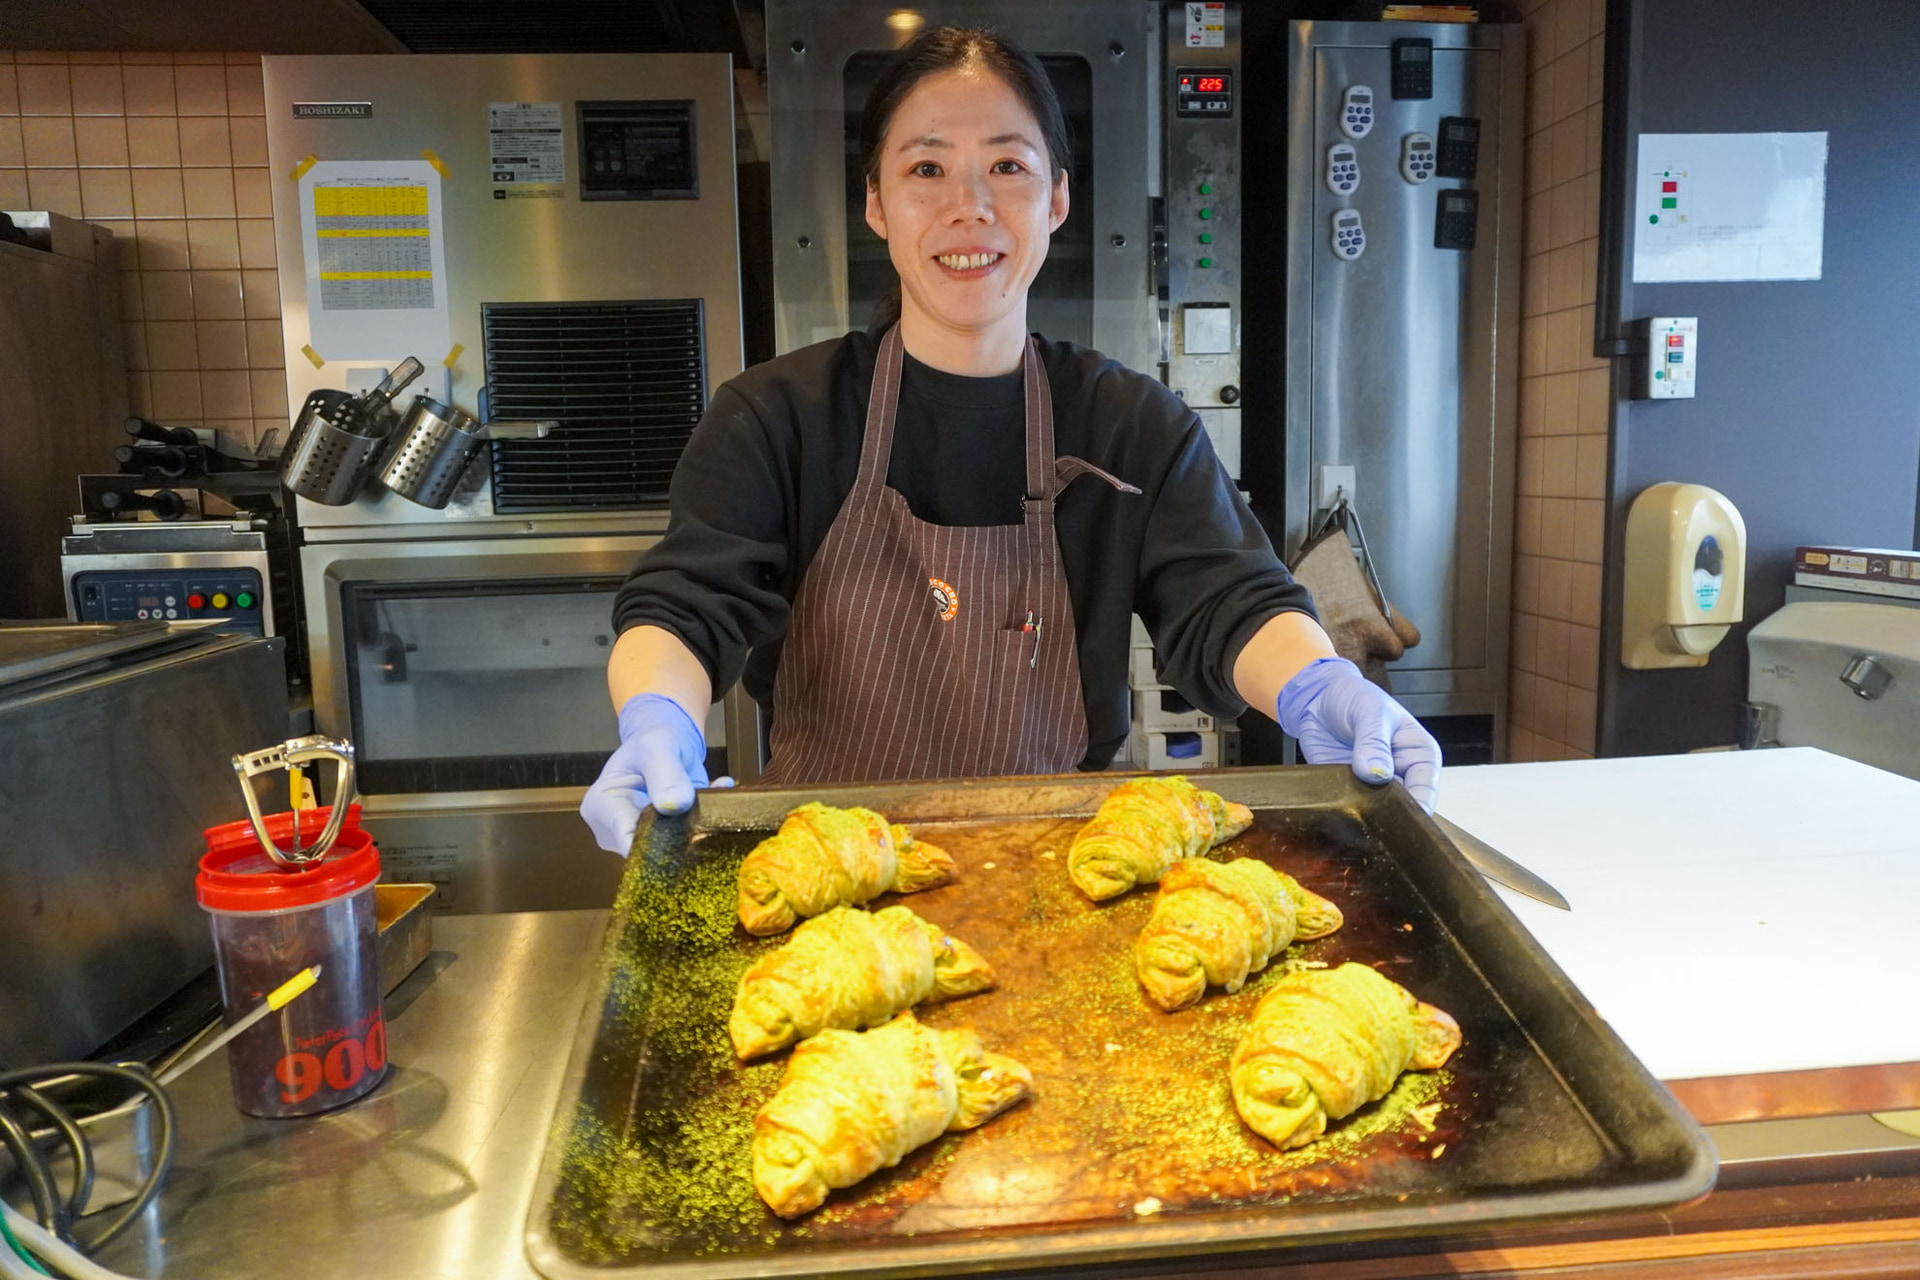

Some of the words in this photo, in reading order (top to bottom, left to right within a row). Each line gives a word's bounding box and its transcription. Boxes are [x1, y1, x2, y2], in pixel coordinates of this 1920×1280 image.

[1199, 78, 1223, 92] 225
[299, 105, 366, 115] HOSHIZAKI
[276, 1020, 386, 1104] 900
